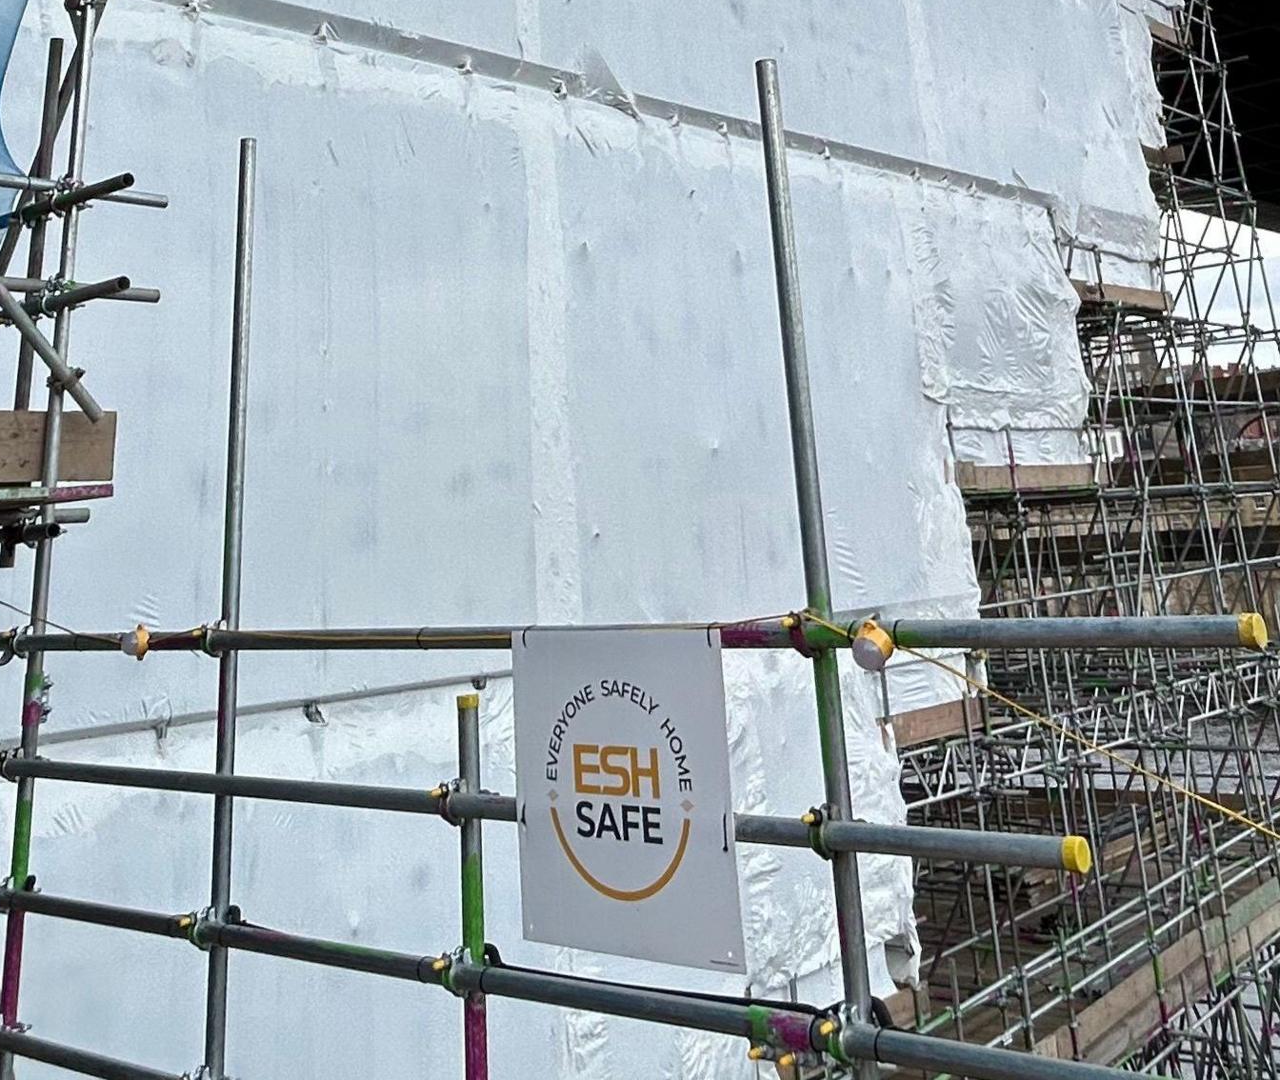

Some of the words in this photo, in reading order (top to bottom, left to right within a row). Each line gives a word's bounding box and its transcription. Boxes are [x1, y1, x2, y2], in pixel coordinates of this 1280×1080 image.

[546, 684, 595, 781] EVERYONE
[600, 680, 659, 715] SAFELY
[660, 718, 693, 792] HOME
[573, 744, 660, 799] ESH
[576, 800, 663, 845] SAFE
